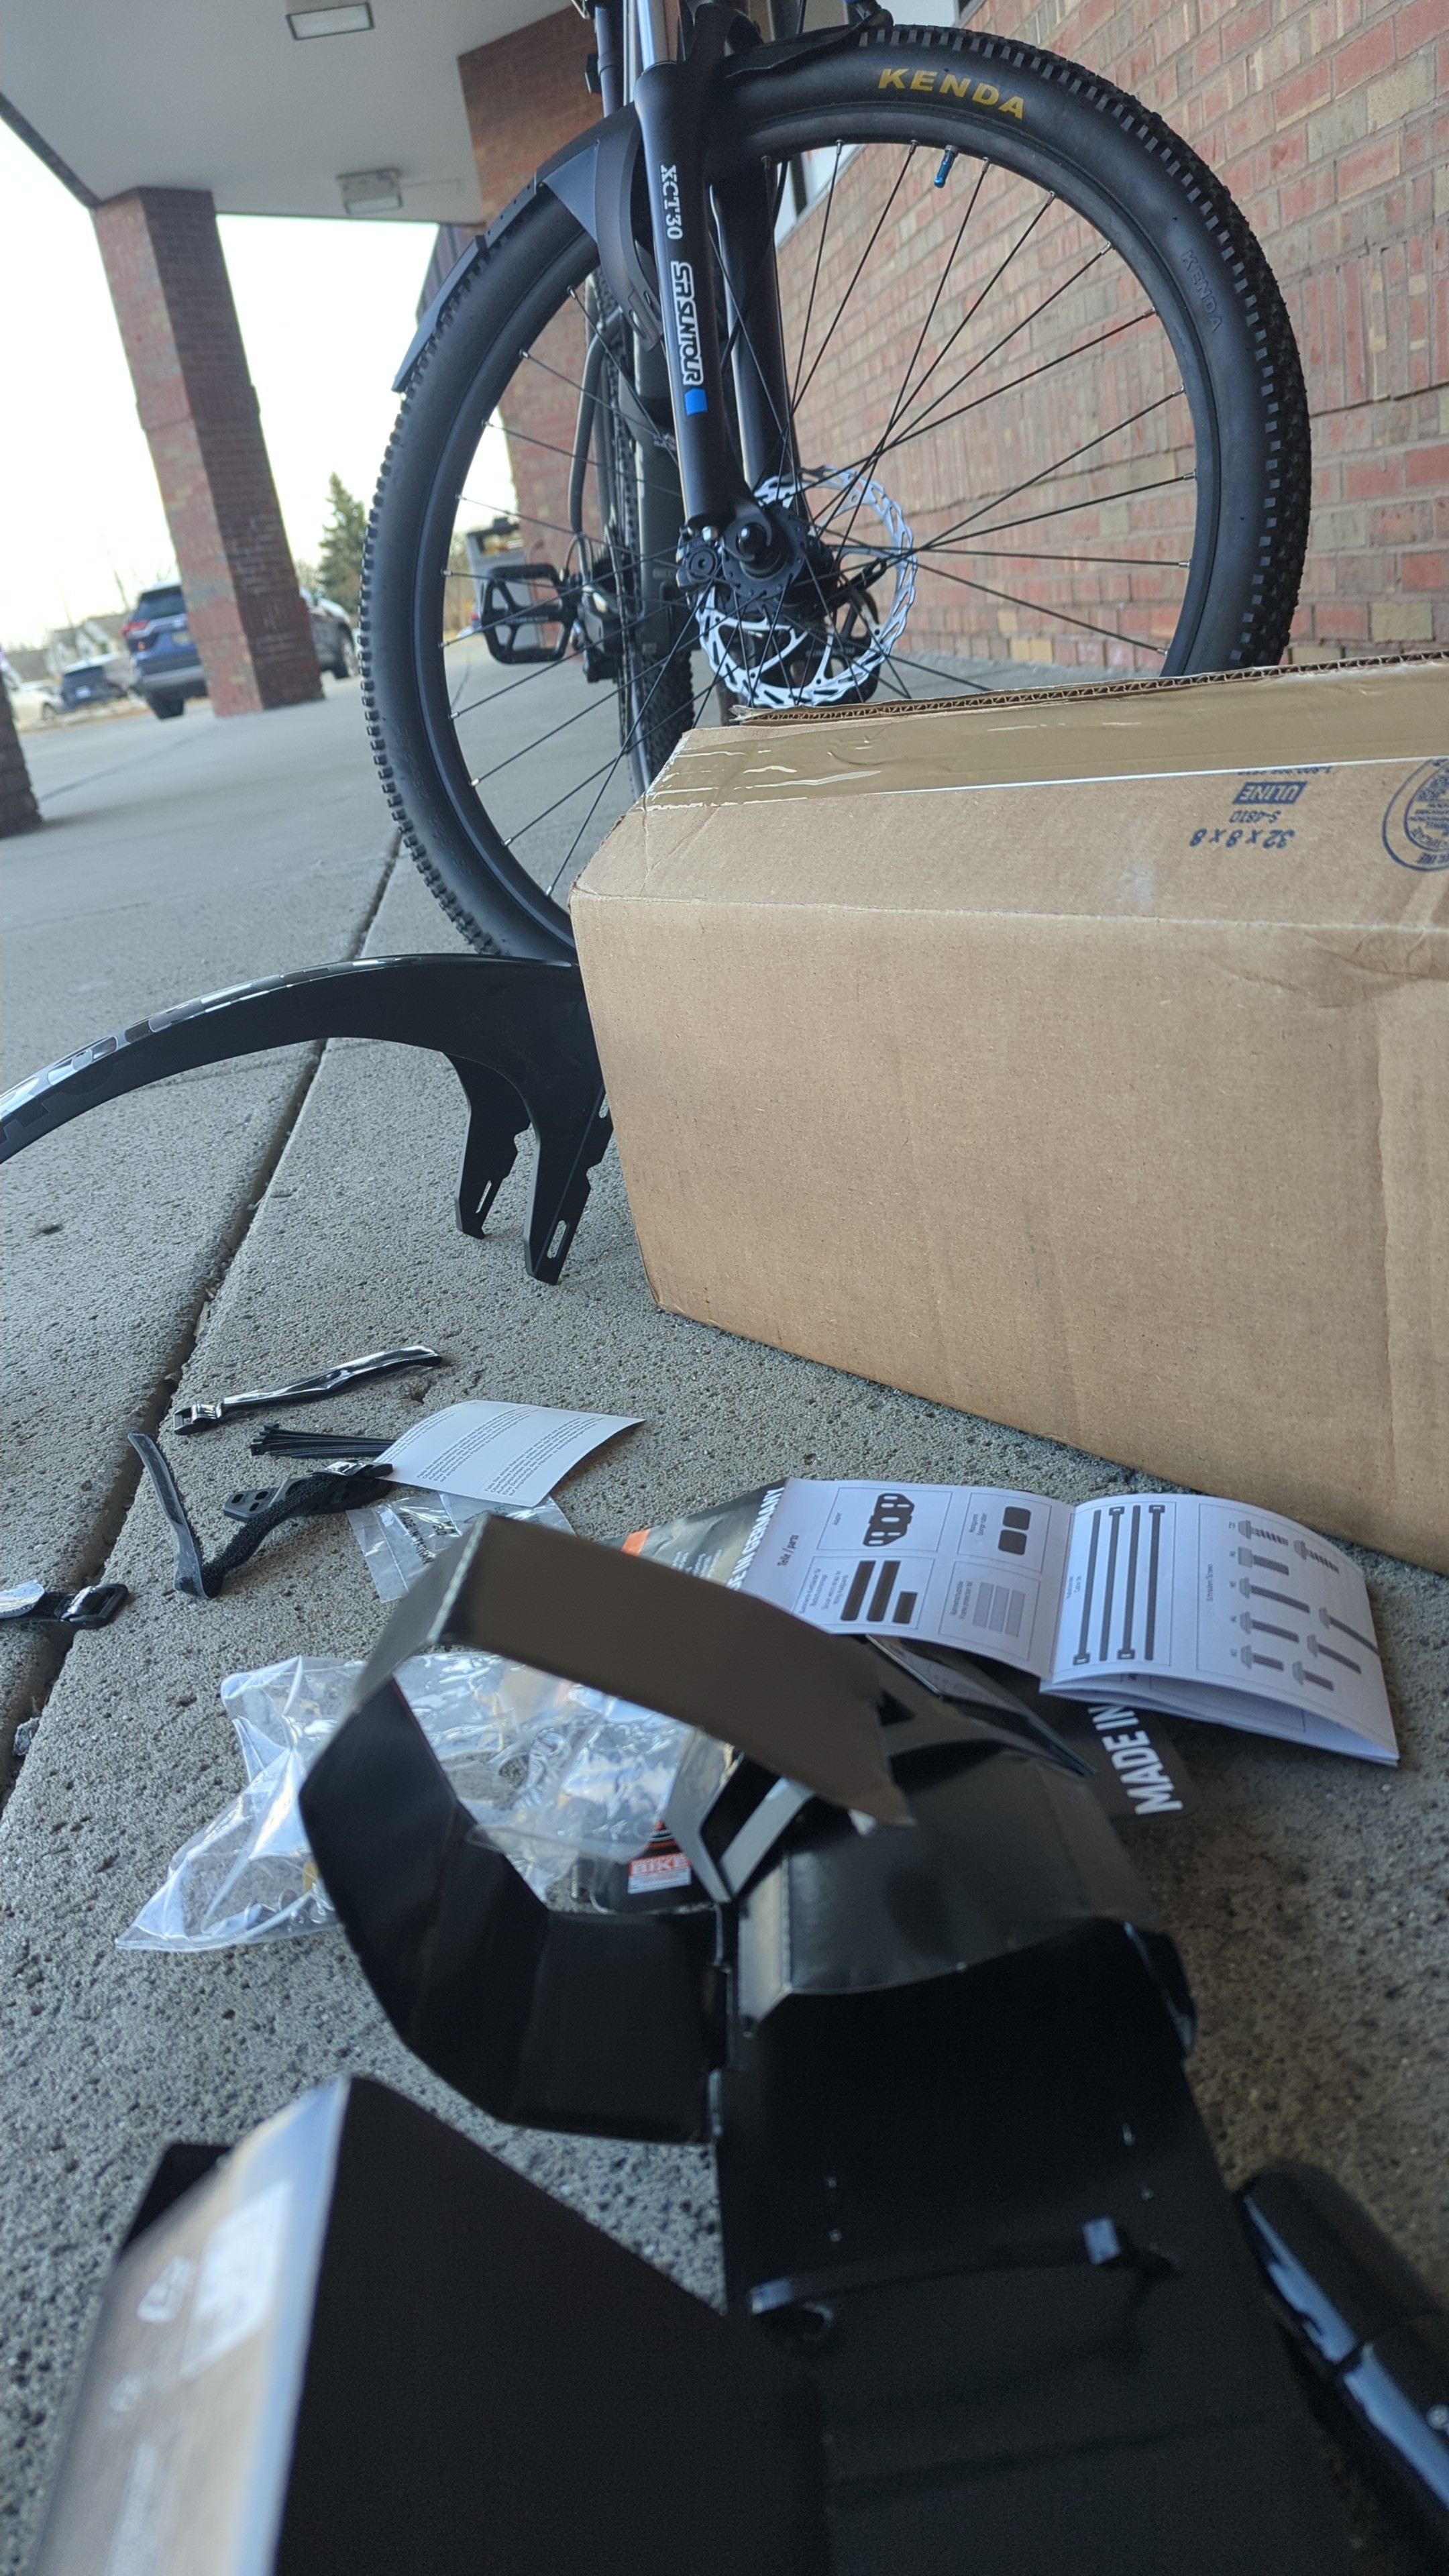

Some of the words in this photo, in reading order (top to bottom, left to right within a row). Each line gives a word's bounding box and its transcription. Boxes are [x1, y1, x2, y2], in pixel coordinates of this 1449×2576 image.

[878, 68, 1024, 121] KENDA
[661, 164, 683, 239] XCT30
[1181, 249, 1222, 333] KENDA
[1238, 784, 1301, 802] ULINE
[1229, 810, 1281, 824] S-4810
[1189, 828, 1208, 847] 8
[1208, 828, 1227, 843] x
[1226, 829, 1244, 848] 8
[1245, 828, 1264, 844] x
[1263, 829, 1295, 849] 32
[741, 1487, 785, 1555] GERMANY
[787, 1534, 800, 1551] parts
[732, 1551, 756, 1575] IN
[1087, 1705, 1140, 1731] IN
[1102, 1730, 1183, 1815] MADE
[631, 1856, 690, 1874] BIKE
